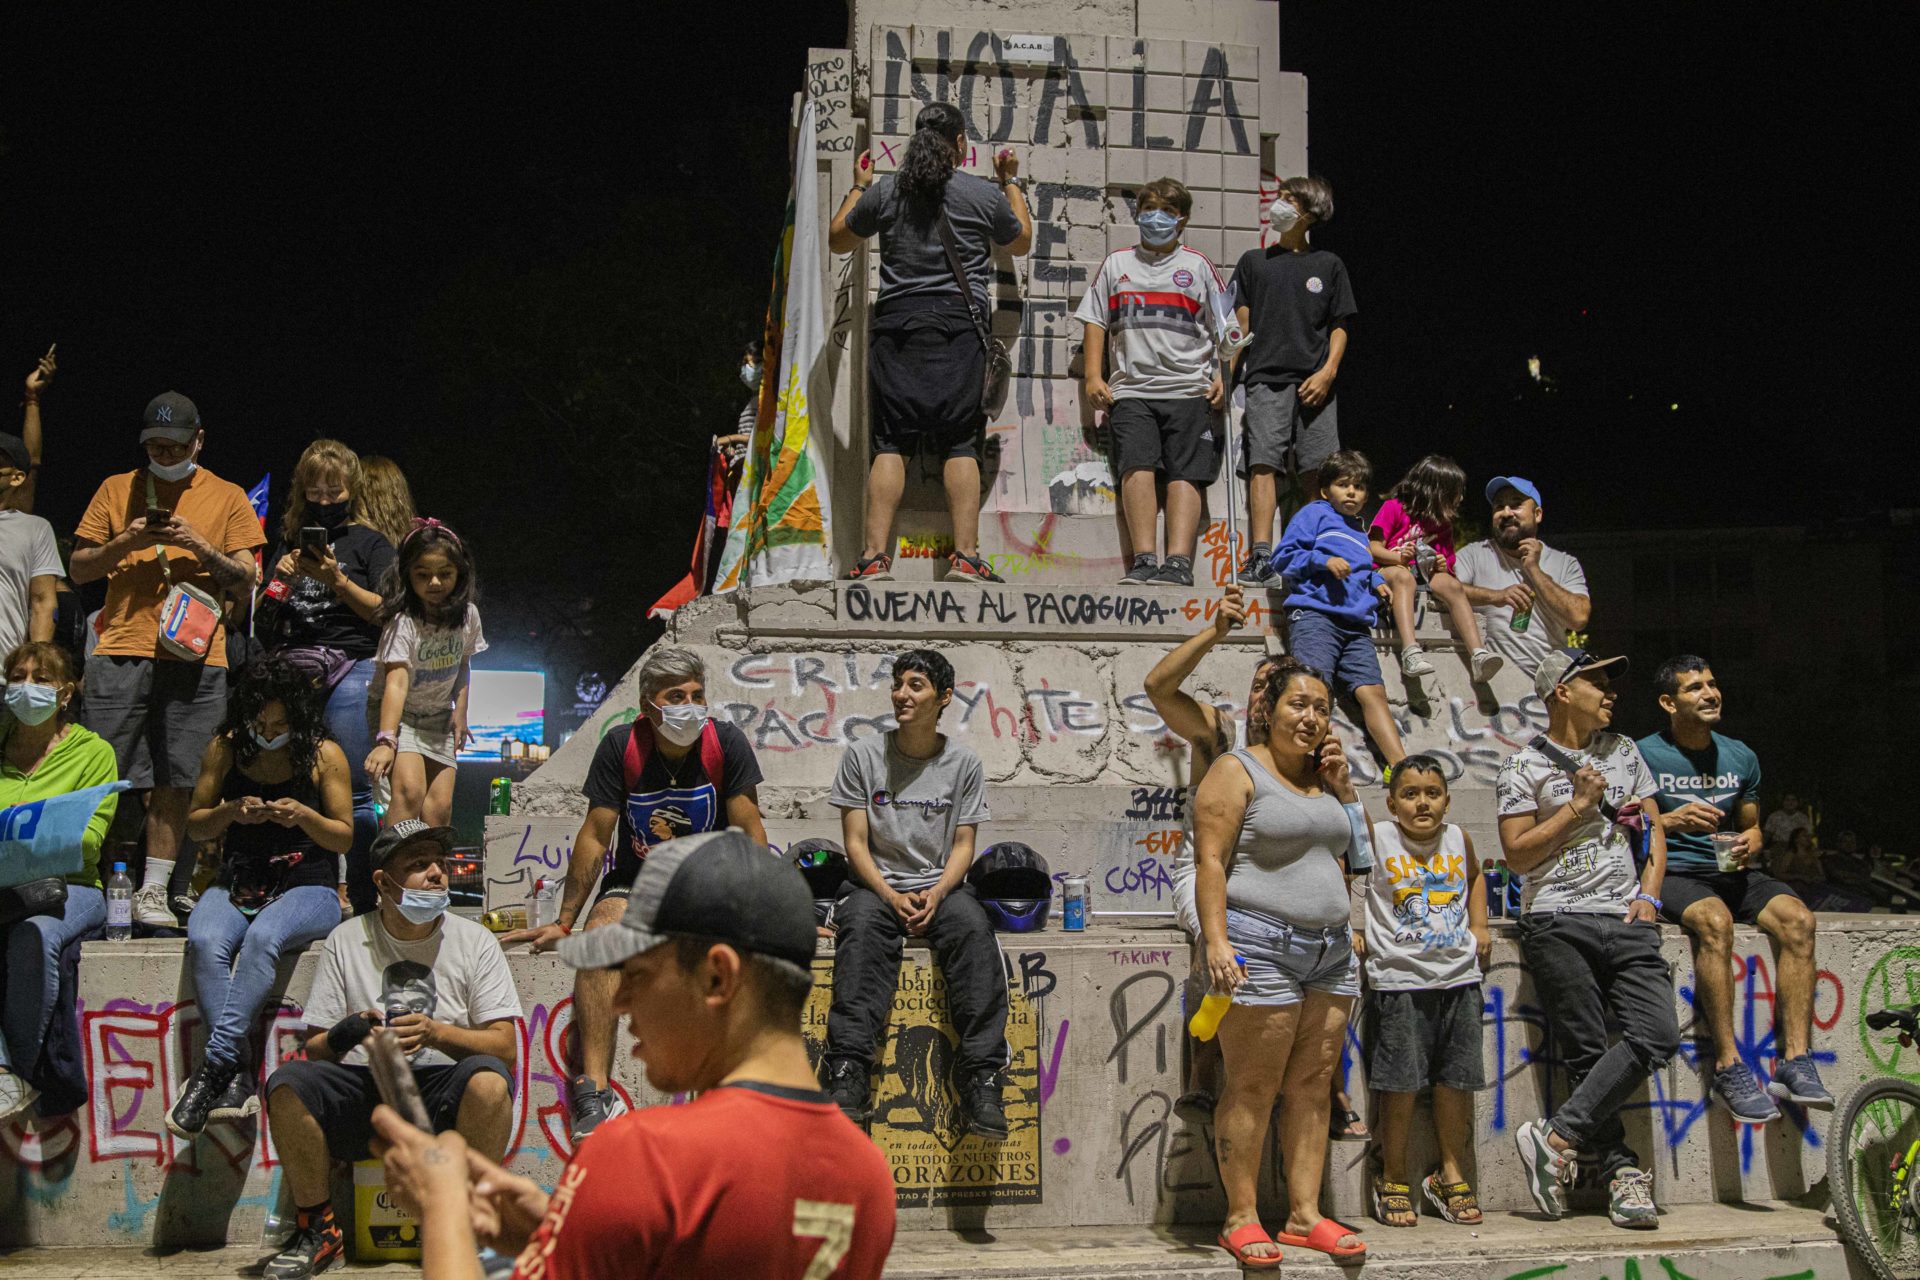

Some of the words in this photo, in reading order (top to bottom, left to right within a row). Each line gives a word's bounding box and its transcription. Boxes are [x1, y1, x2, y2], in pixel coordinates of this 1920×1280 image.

[1012, 42, 1043, 50] A.C.A.B
[882, 30, 1017, 145] NO
[1033, 35, 1100, 149] A
[1131, 39, 1252, 156] LA
[845, 583, 968, 624] QUEMA
[976, 589, 1017, 624] AL
[1659, 772, 1740, 793] Reebok
[872, 790, 954, 821] Champion
[1384, 852, 1466, 885] SHARK
[1394, 932, 1423, 944] CAR
[906, 1139, 938, 1151] todas
[981, 1139, 1022, 1152] formas
[891, 1154, 910, 1165] DE
[913, 1154, 960, 1166] TODOS
[963, 1151, 1031, 1163] NUESTROS
[893, 1162, 1037, 1184] ORAZONES
